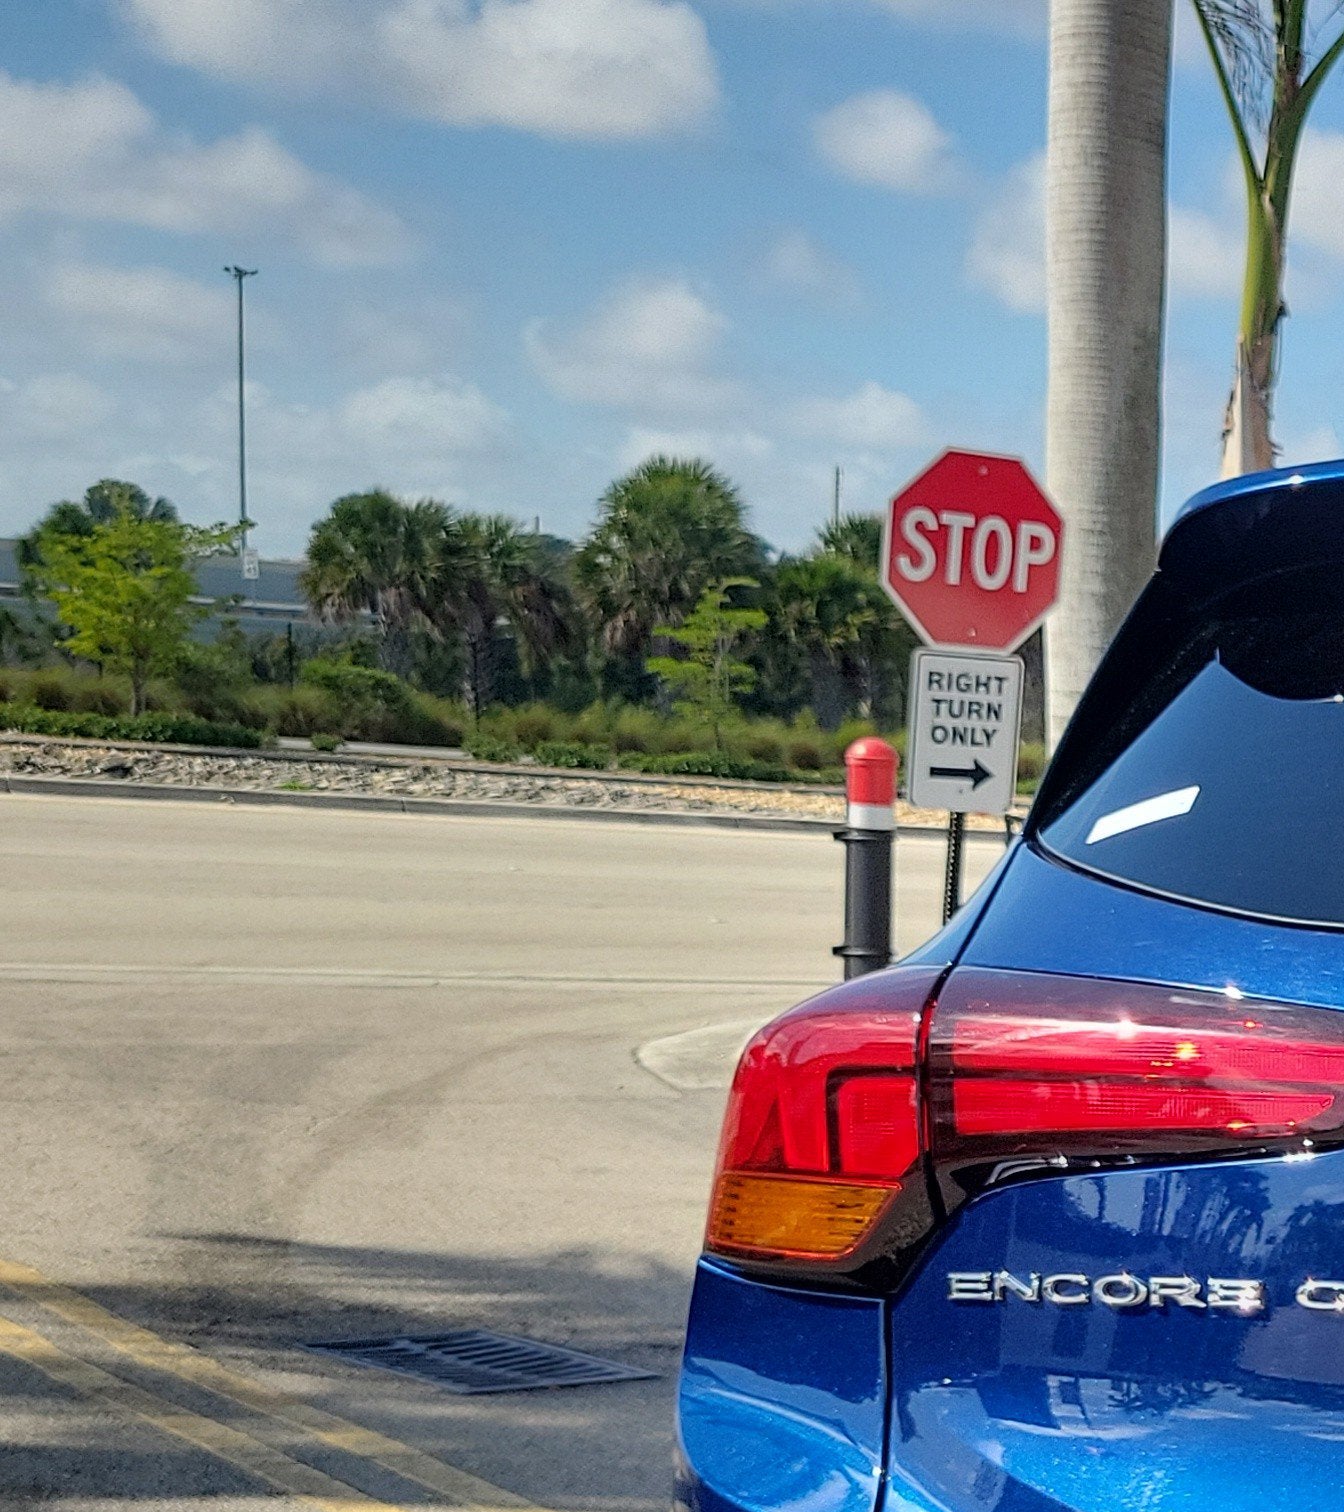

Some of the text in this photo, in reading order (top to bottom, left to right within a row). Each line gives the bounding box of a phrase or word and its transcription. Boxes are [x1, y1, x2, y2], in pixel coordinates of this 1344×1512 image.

[895, 506, 1056, 593] STOP
[927, 670, 1010, 695] RIGHT
[930, 698, 1003, 723] TURN
[930, 725, 998, 748] ONLY
[946, 1269, 1266, 1310] ENCORE
